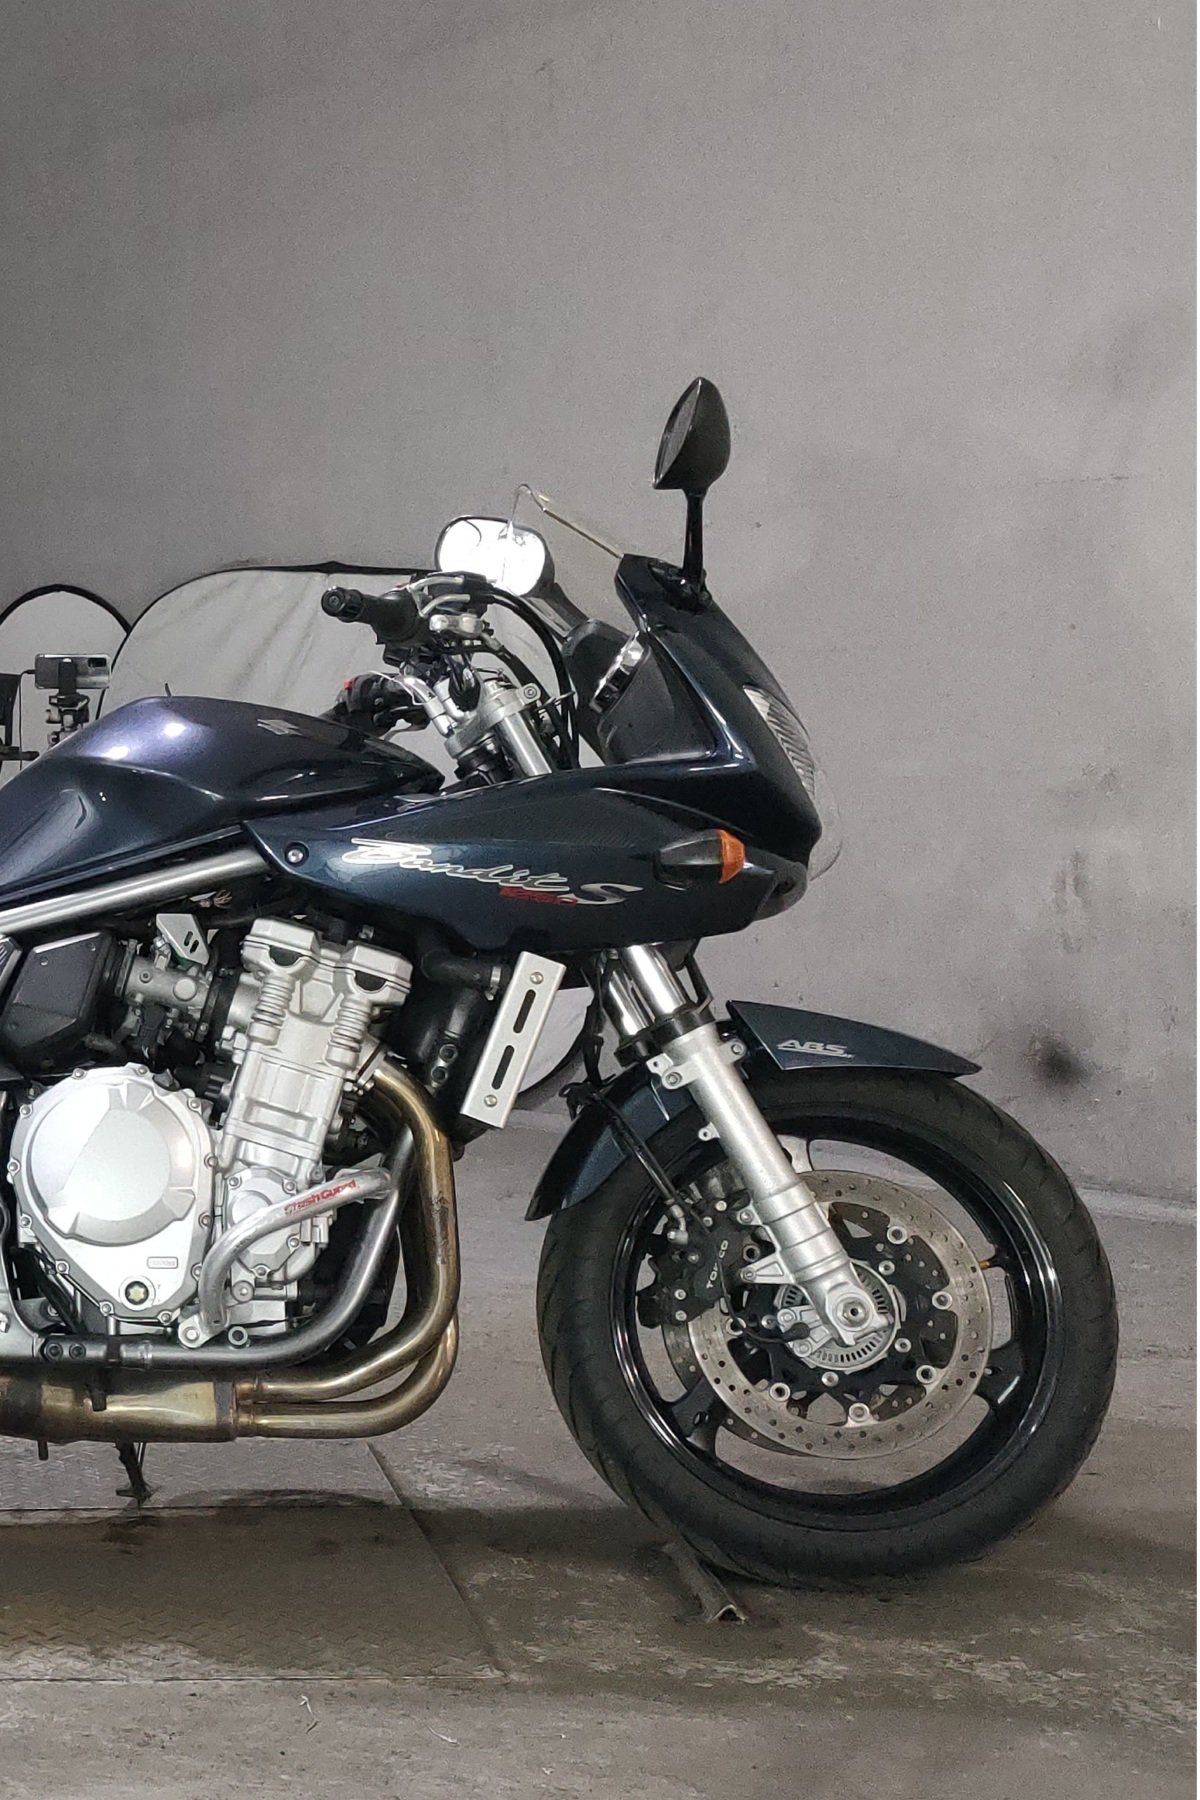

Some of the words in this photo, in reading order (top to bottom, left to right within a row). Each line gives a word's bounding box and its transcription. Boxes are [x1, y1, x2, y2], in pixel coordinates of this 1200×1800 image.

[342, 837, 570, 892] Bandit
[557, 882, 644, 905] S
[776, 1040, 848, 1056] ABS
[706, 1240, 728, 1289] TOKCO
